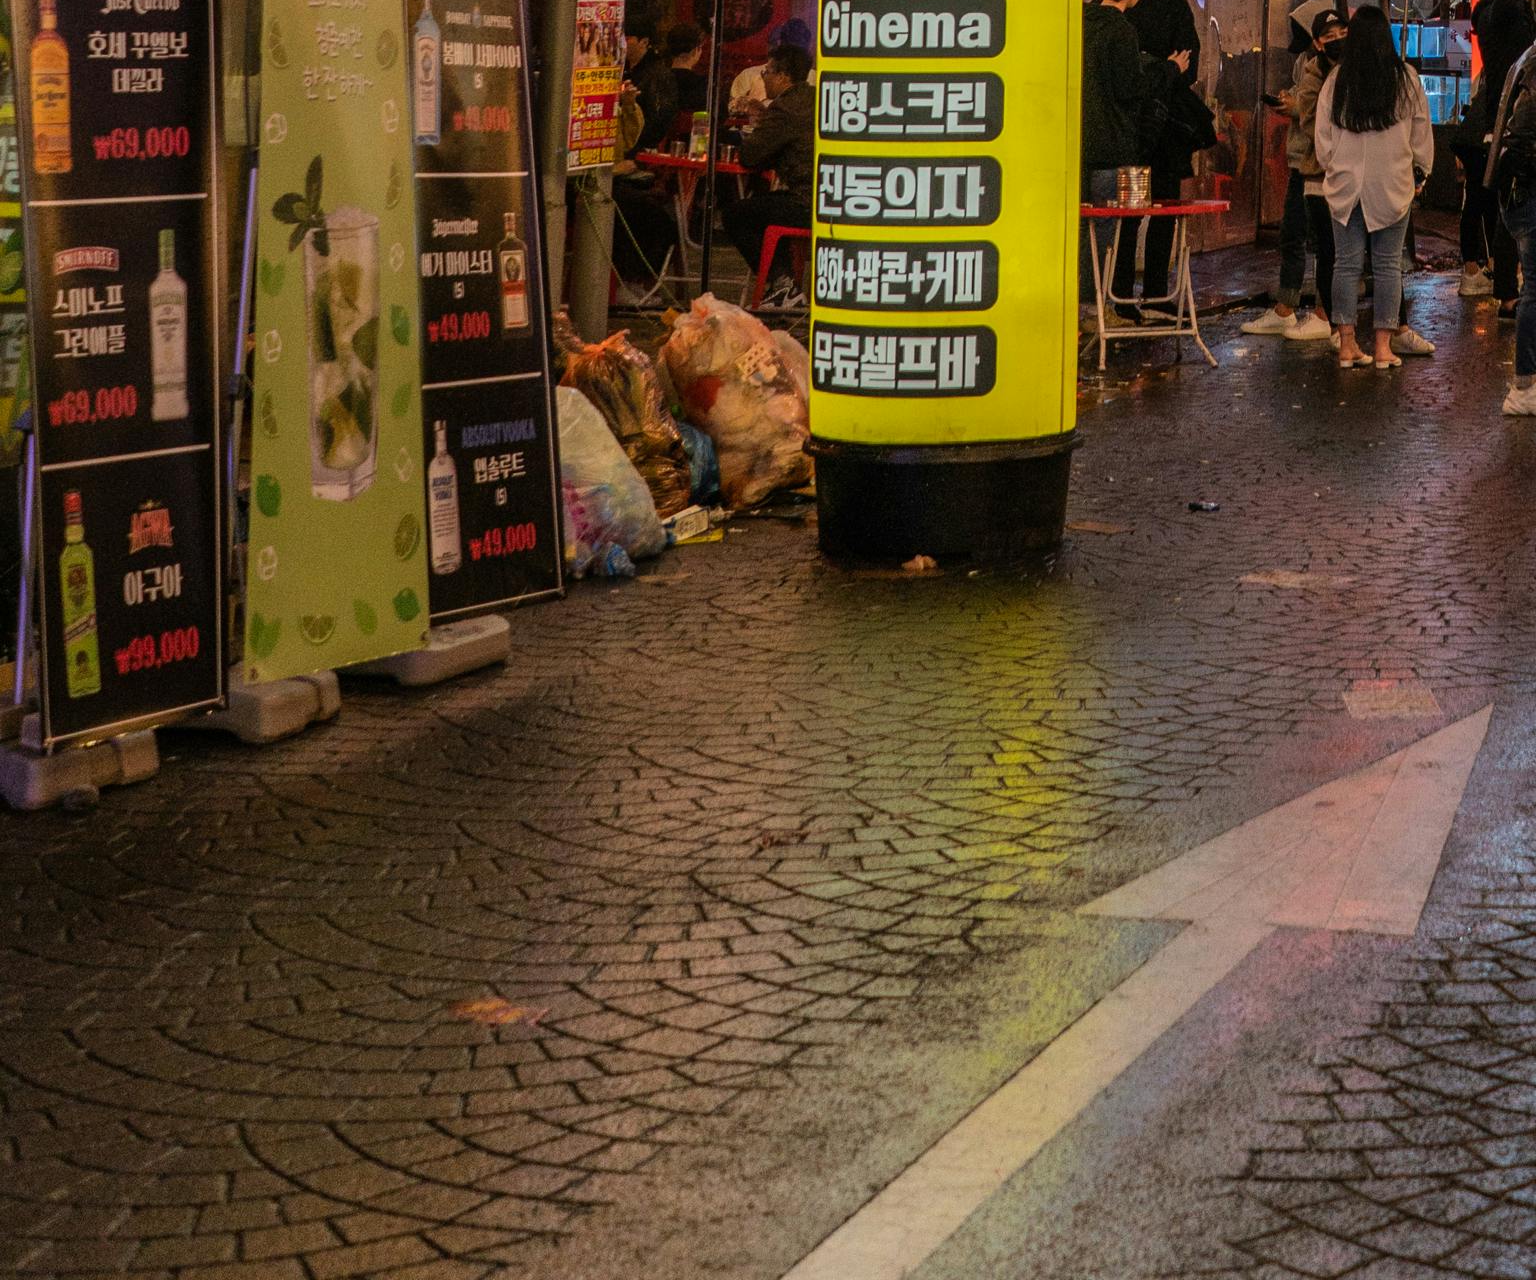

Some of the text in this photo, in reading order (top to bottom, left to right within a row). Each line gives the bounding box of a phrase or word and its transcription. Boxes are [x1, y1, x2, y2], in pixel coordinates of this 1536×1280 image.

[87, 31, 126, 60] 호세
[819, 80, 987, 136] 대형스크린
[817, 164, 985, 221] 진동의자
[53, 284, 126, 318] 스미노프
[814, 248, 985, 305] 영화+팝콘+커피
[53, 322, 127, 360] 그린애플
[813, 334, 979, 393] 무료셀프바
[123, 564, 183, 607] 아구아
